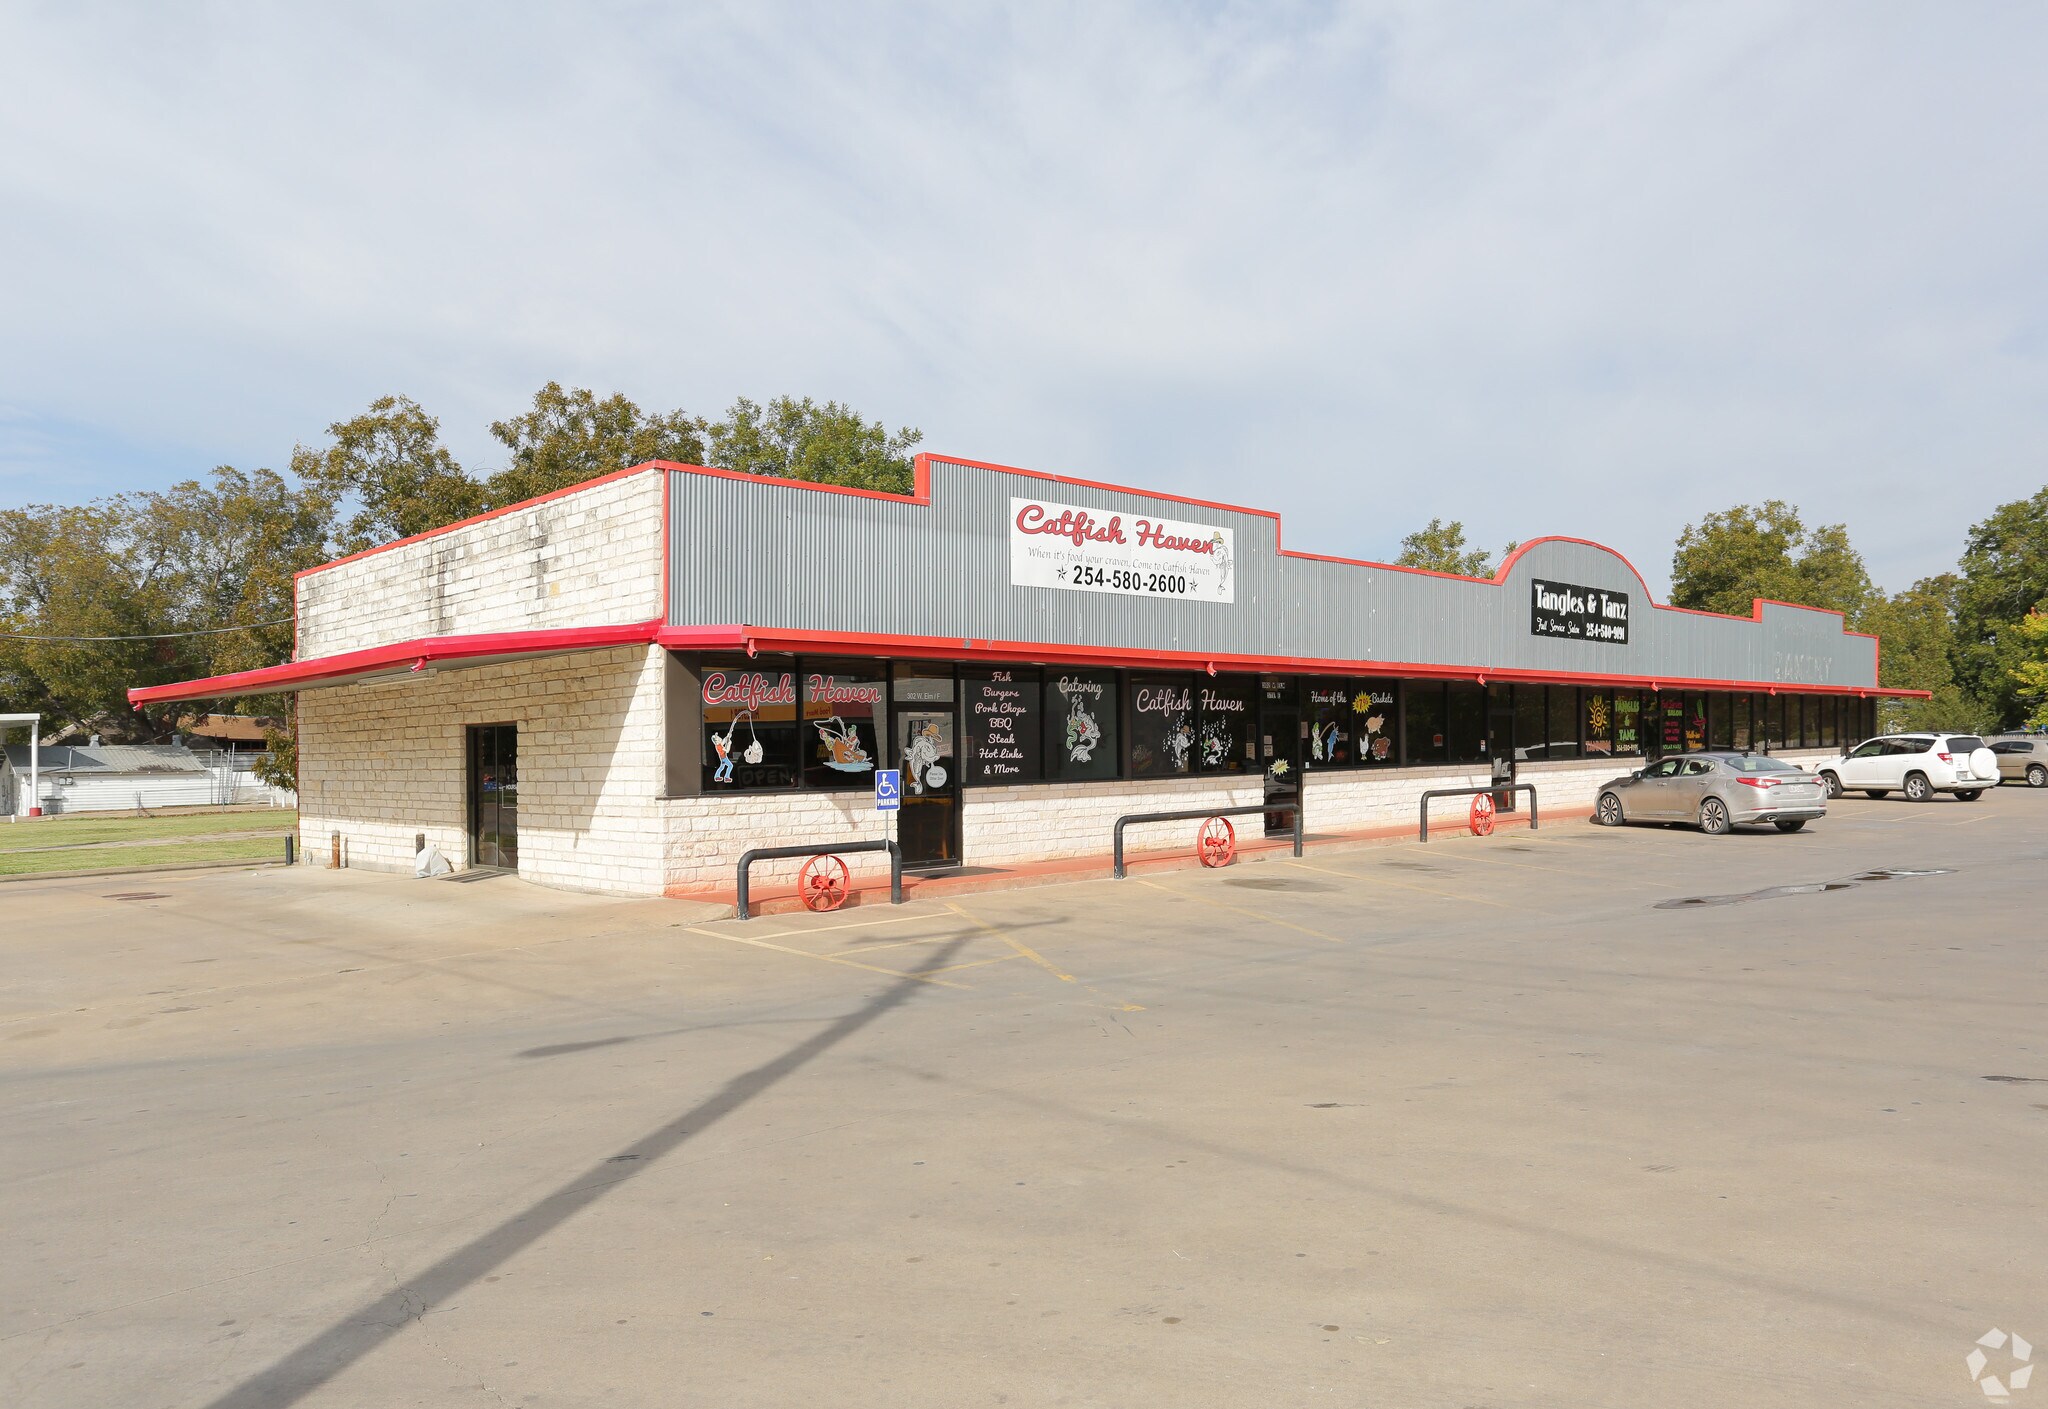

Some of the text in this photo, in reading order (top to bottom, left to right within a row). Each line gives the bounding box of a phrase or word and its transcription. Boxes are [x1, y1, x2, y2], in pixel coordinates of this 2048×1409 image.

[1016, 505, 1214, 554] Catfish Haven
[1028, 545, 1051, 559] When
[1053, 550, 1065, 560] it's
[1065, 549, 1085, 566] food
[1085, 555, 1103, 565] your
[1132, 559, 1152, 569] Come
[1154, 562, 1161, 570] to
[1162, 561, 1187, 575] Catfish
[1189, 563, 1210, 575] Haven
[1073, 565, 1186, 593] 254-580-2600
[1534, 583, 1627, 620] Tangles & Tanz
[1536, 617, 1580, 634] Full Service Salon
[991, 671, 1012, 682] Fish
[702, 672, 882, 711] Catfish Haven
[982, 686, 1020, 701] Burgers
[1058, 675, 1103, 700] Catering
[906, 692, 916, 700] 302
[924, 692, 933, 700] Elm
[1136, 688, 1245, 717] Catfish Haven
[1311, 691, 1347, 706] Home of the
[1370, 692, 1393, 704] Baskets
[974, 702, 1027, 716] Pork Chops
[988, 717, 1012, 730] BBQ
[987, 733, 1016, 744] Steak
[1619, 729, 1636, 741] TANZ
[979, 748, 1024, 759] Hot Links
[983, 764, 1020, 774] & More
[742, 769, 790, 785] OPEN
[877, 798, 898, 806] PARKING
